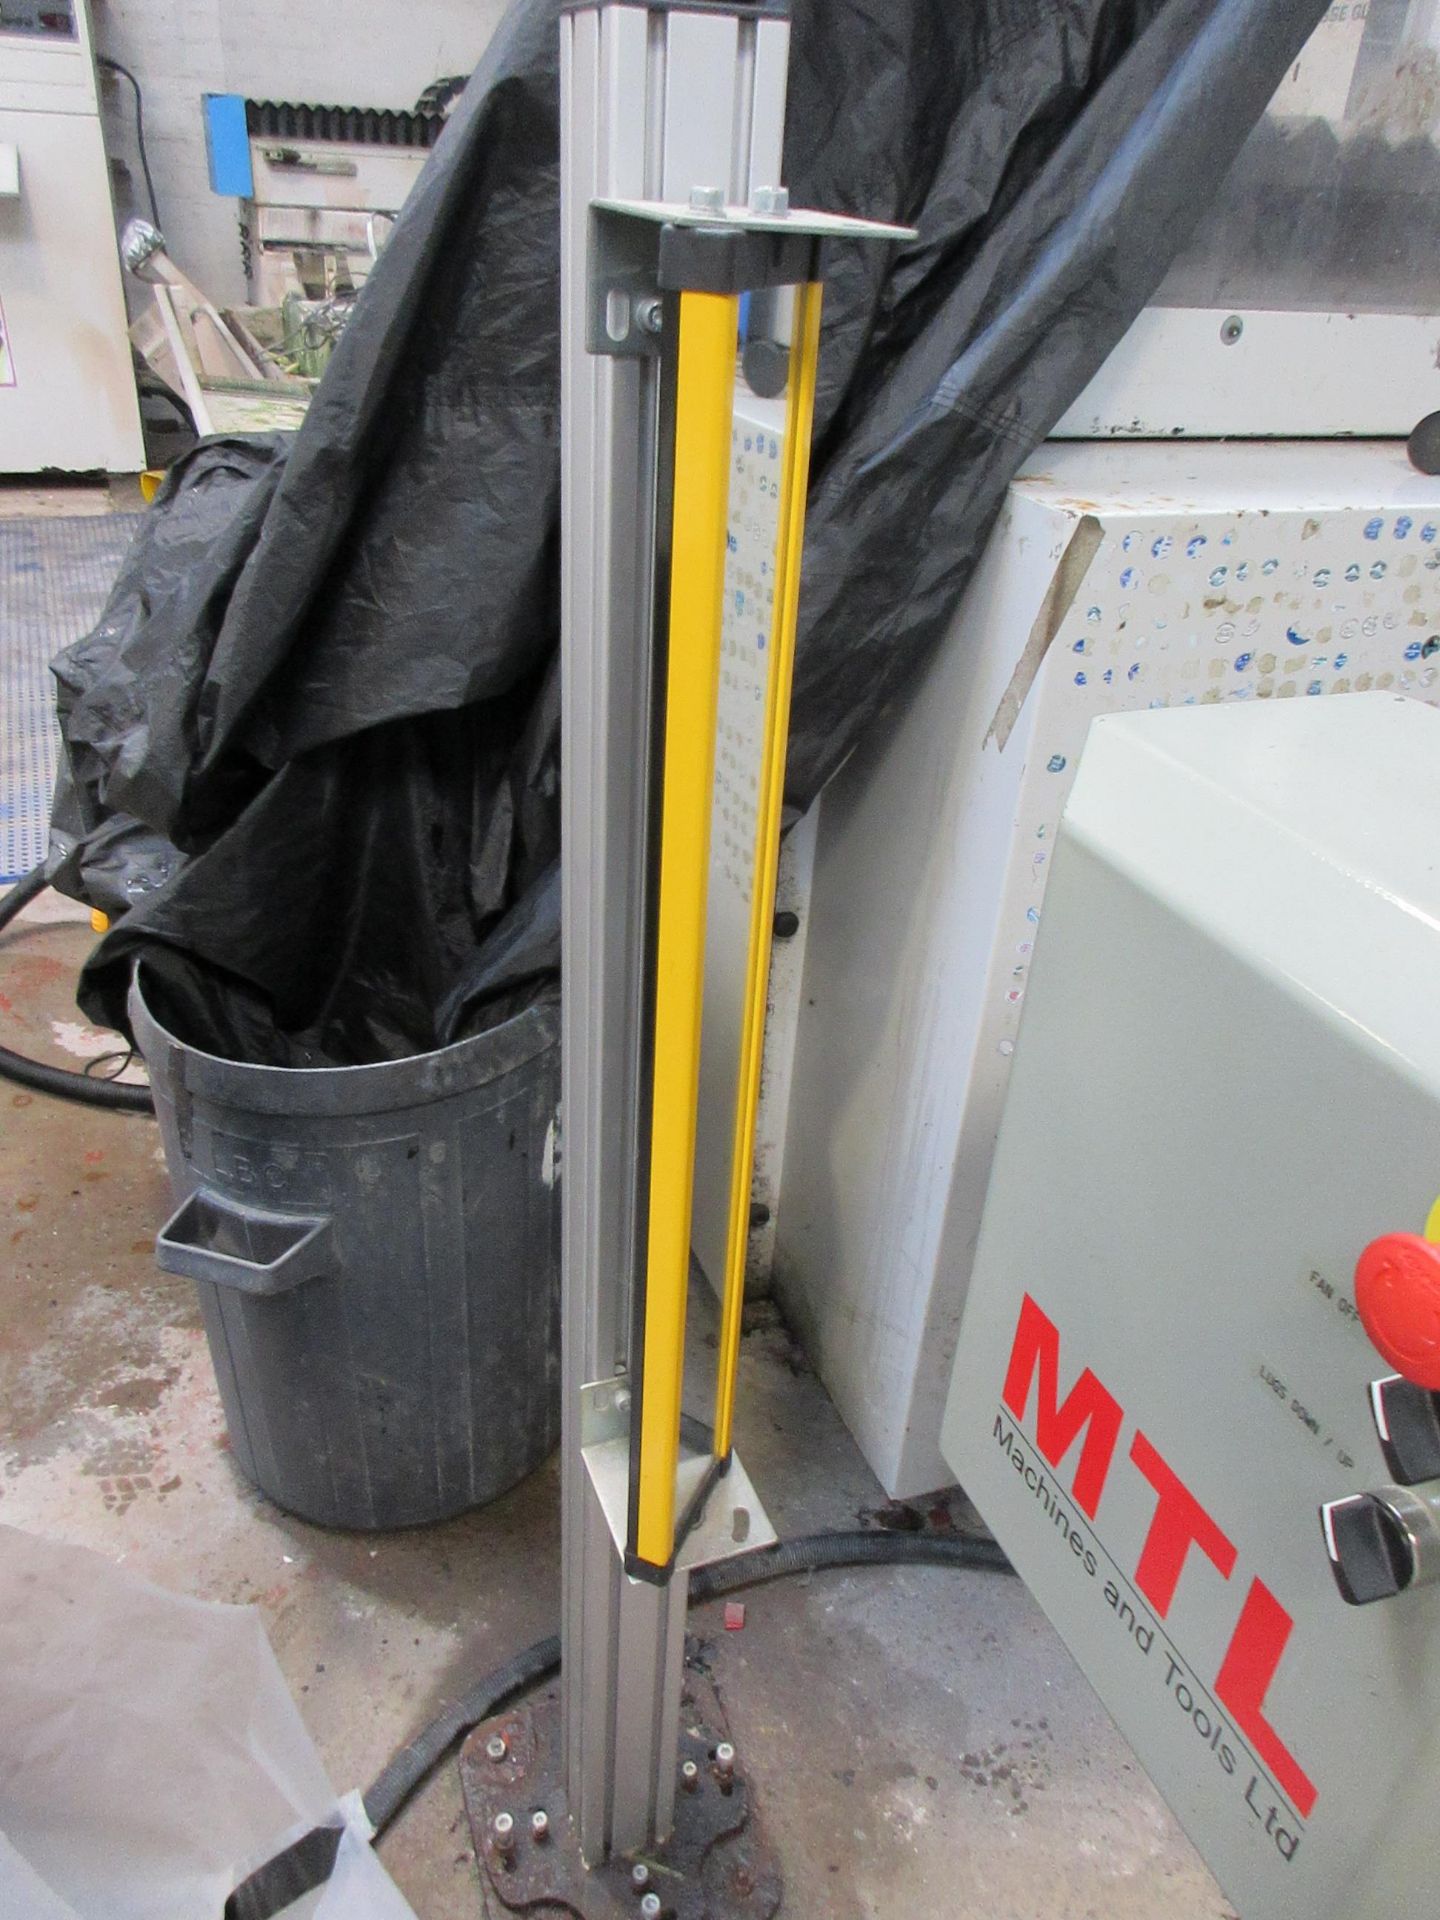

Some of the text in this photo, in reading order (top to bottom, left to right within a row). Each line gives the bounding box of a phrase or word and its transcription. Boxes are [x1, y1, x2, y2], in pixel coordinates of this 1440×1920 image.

[1258, 1364, 1289, 1399] LUGS
[1290, 1398, 1321, 1436] DOWN
[1336, 1448, 1355, 1469] UP
[1309, 1270, 1335, 1299] FAN
[992, 1414, 1300, 1863] Machines and Tools Ltd
[1002, 1292, 1319, 1819] MTL
